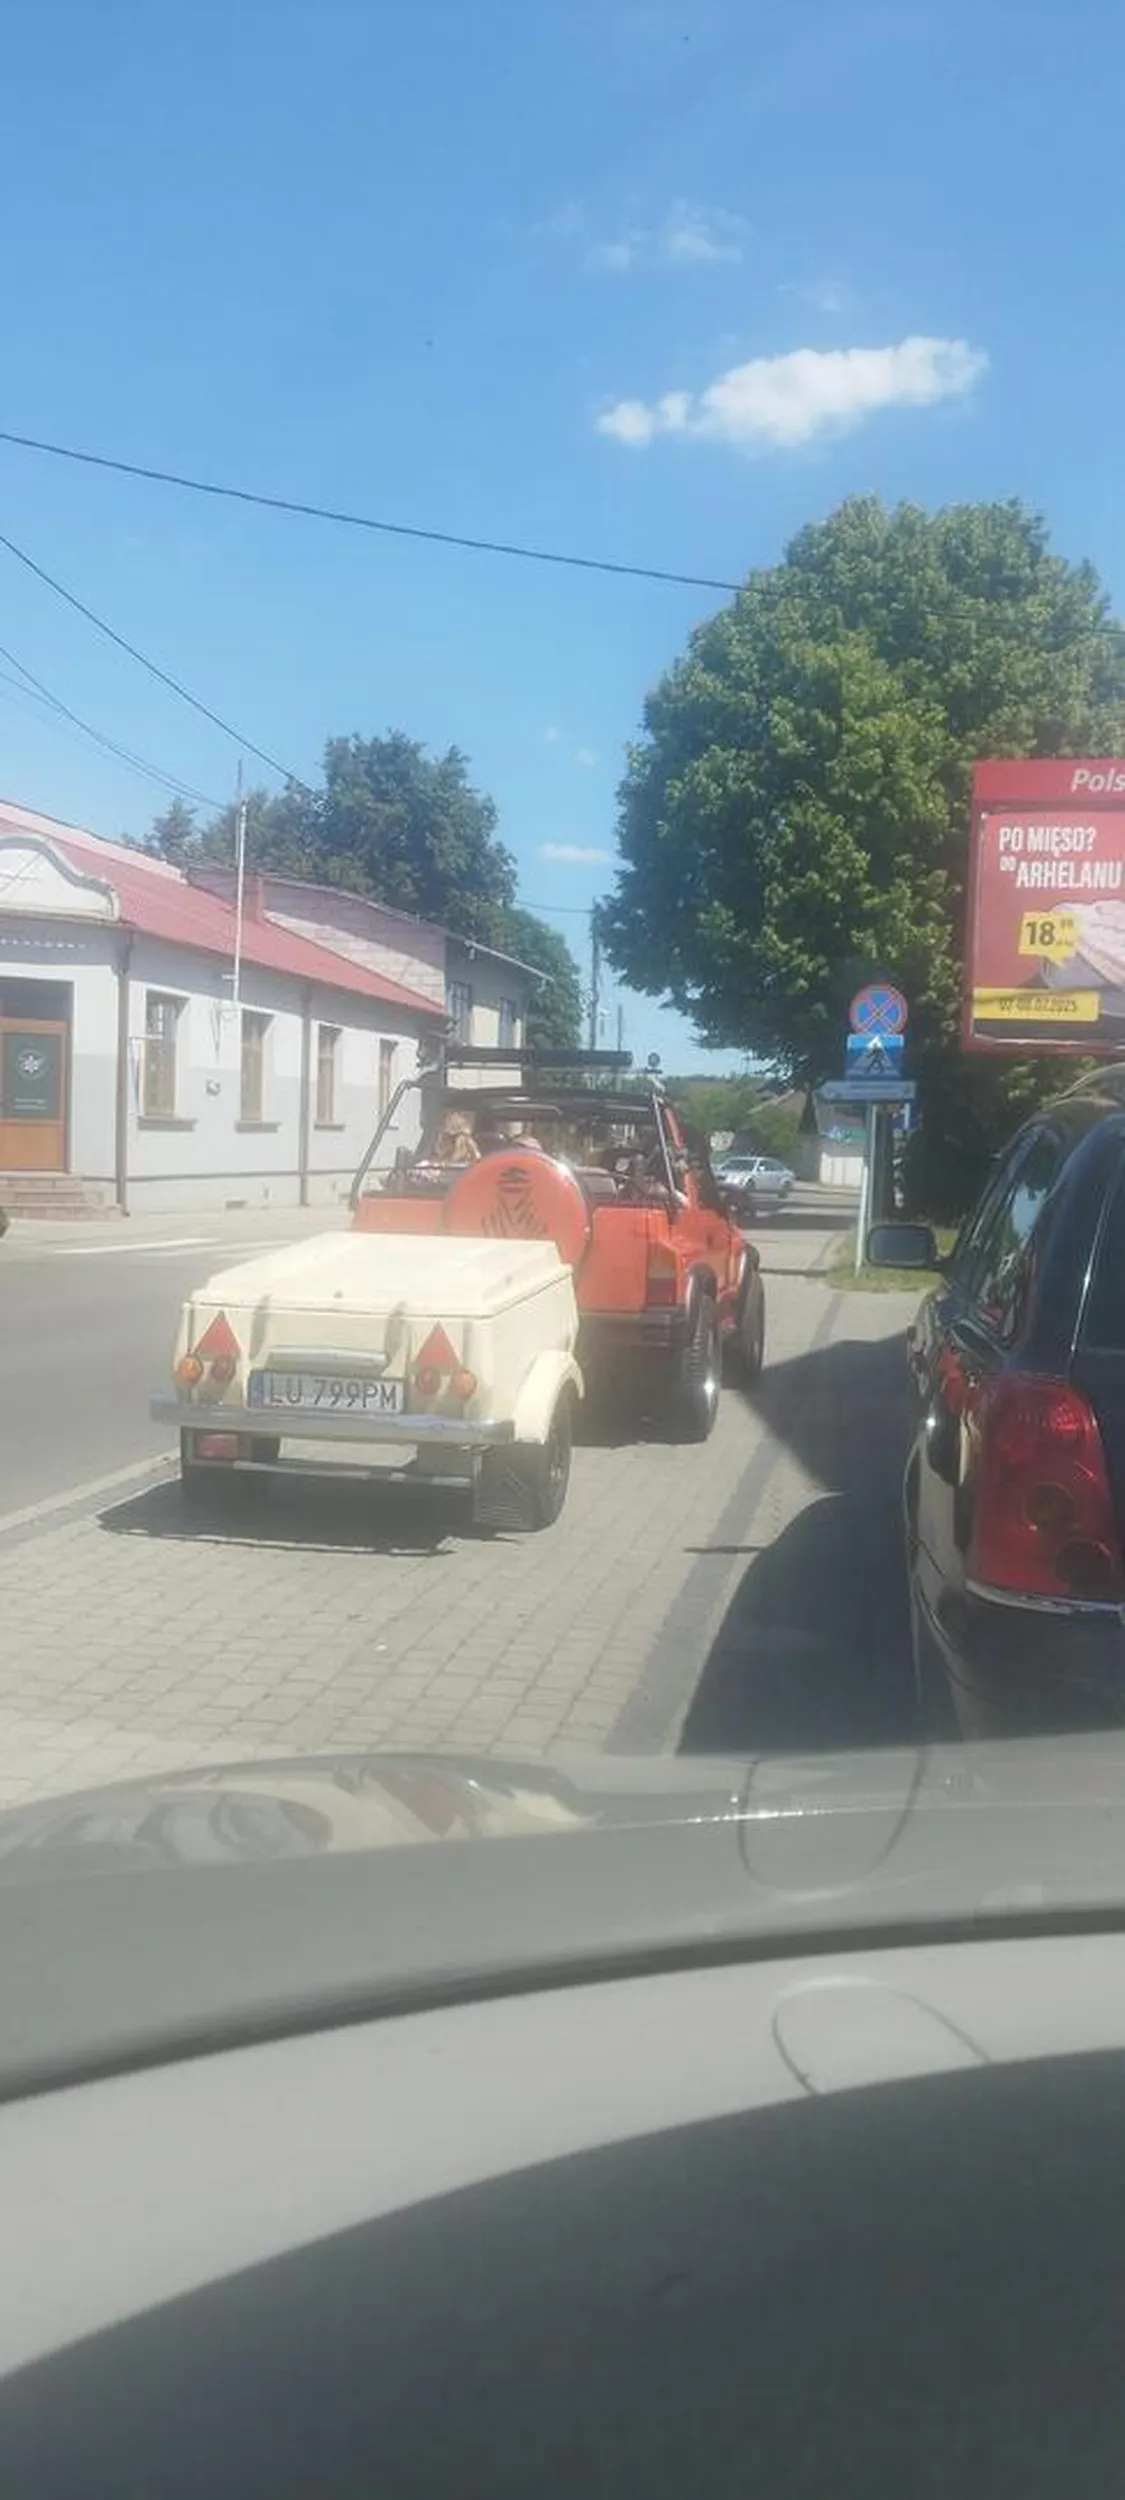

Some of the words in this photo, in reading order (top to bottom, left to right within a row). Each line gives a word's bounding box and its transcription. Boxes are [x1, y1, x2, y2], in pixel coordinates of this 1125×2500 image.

[999, 827, 1023, 852] PO
[1027, 826, 1097, 858] MIĘSO?
[1016, 861, 1121, 888] ARHELANU
[1026, 920, 1056, 946] 18
[270, 1372, 302, 1404] LU
[314, 1379, 397, 1410] 799PM
